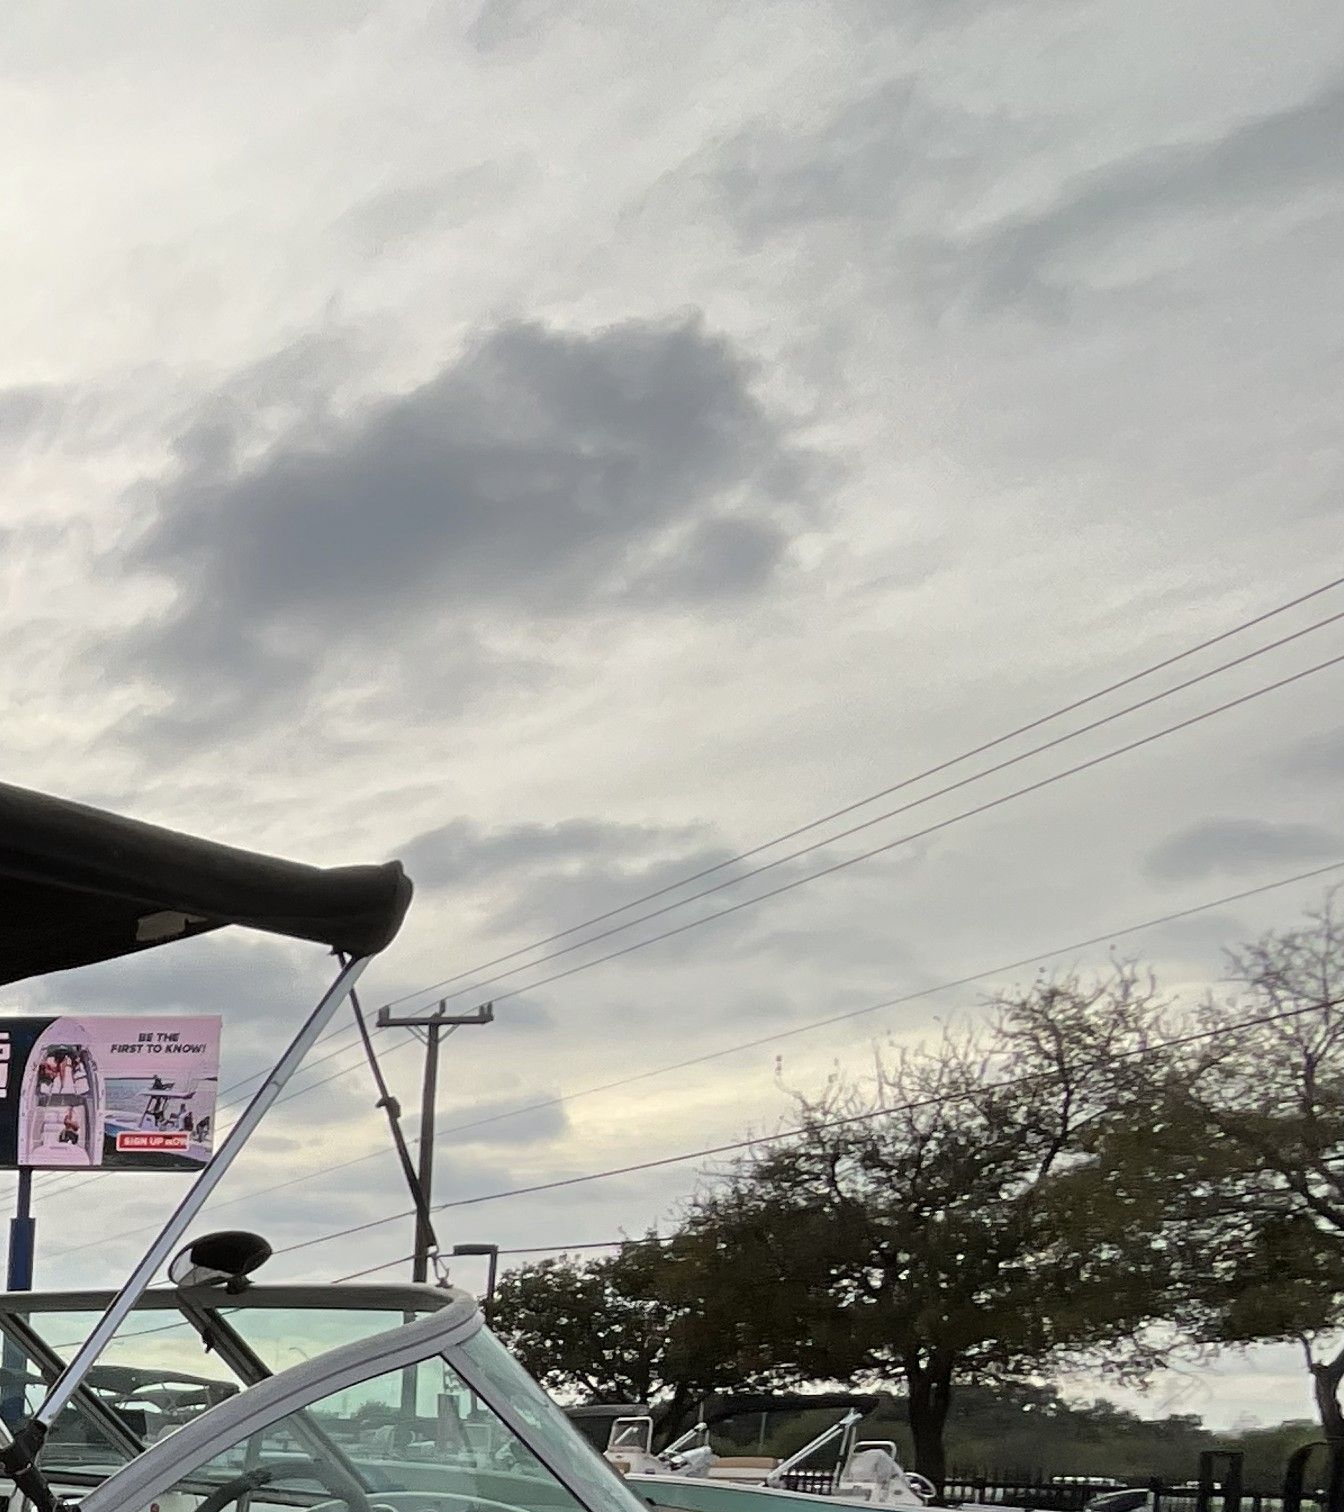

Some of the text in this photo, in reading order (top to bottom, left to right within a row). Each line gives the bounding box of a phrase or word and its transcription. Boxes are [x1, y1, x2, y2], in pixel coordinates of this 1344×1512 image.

[138, 1032, 180, 1042] BE THE
[110, 1043, 207, 1053] FIRST TO KNOW!
